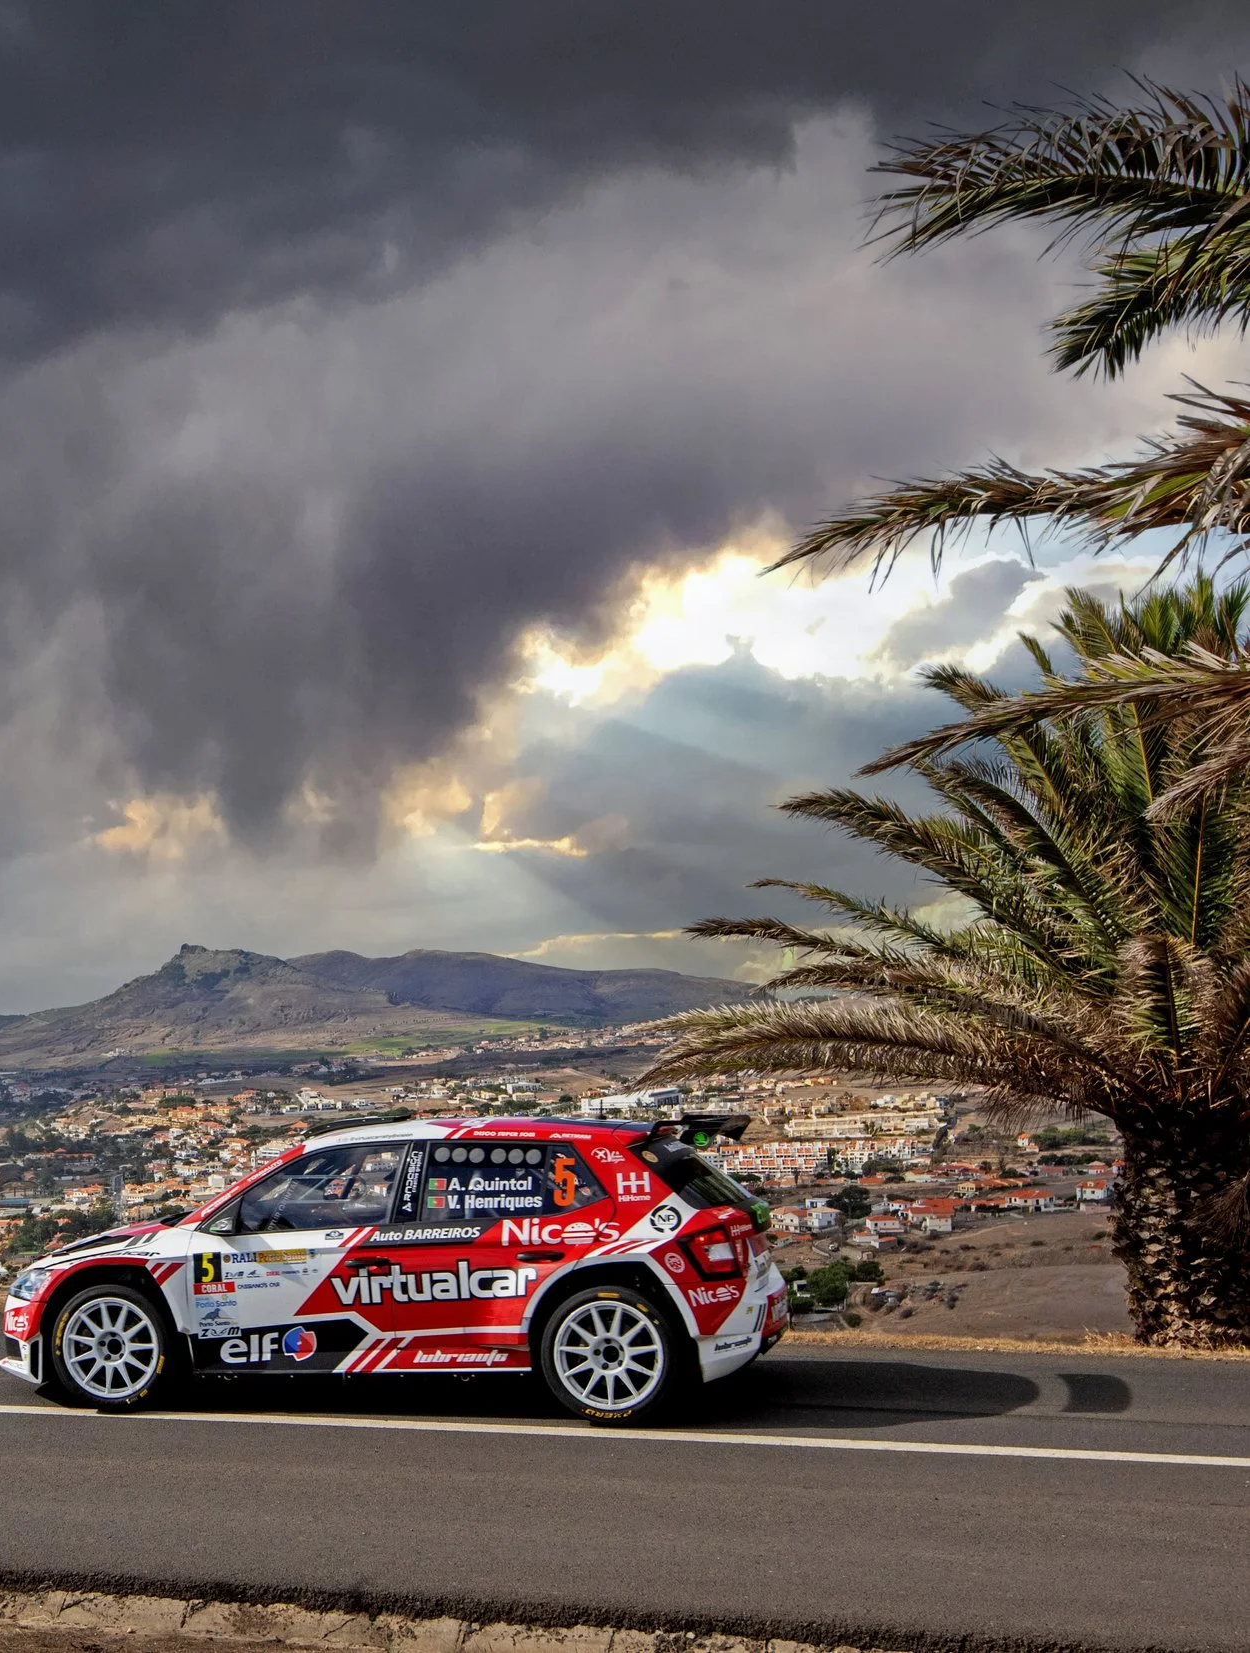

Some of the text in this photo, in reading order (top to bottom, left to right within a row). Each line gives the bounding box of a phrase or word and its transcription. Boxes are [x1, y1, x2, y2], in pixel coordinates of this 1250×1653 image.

[448, 1176, 533, 1192] A. Quintal
[552, 1157, 576, 1207] 5
[447, 1193, 543, 1212] V. Henriques
[618, 1194, 652, 1203] HiHome
[370, 1226, 482, 1242] Auto BARREIROS
[201, 1251, 216, 1283] 5
[201, 1283, 228, 1293] CORAL
[330, 1259, 538, 1306] virtualcar
[215, 1300, 238, 1308] Santo
[220, 1332, 280, 1364] elf
